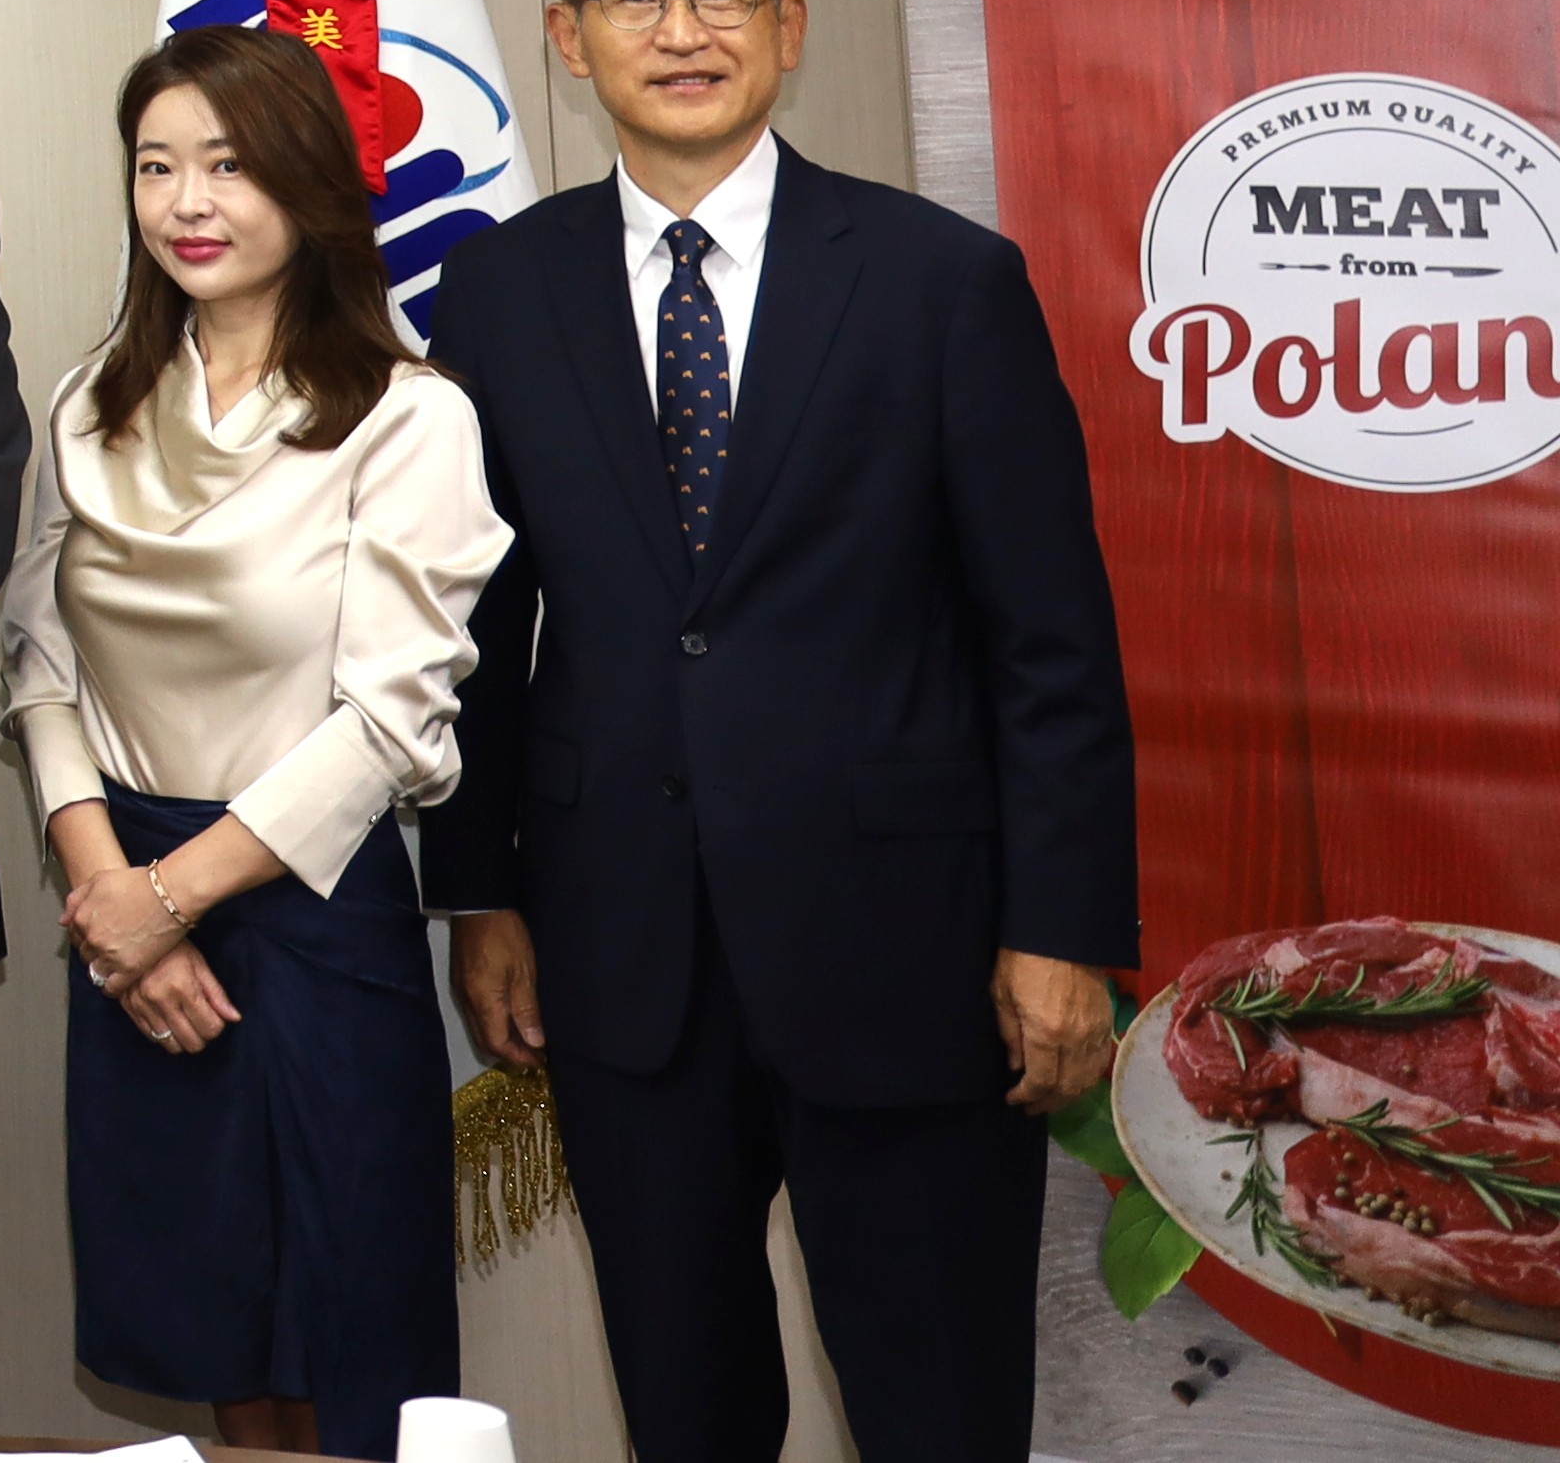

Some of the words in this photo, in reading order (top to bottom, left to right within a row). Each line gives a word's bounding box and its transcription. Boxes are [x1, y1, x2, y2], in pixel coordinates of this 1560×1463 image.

[1221, 99, 1372, 163] PREMIUM
[1387, 101, 1538, 175] QUALITY
[1249, 185, 1500, 240] MEAT
[1339, 252, 1418, 277] from
[1148, 297, 1560, 427] Polan
